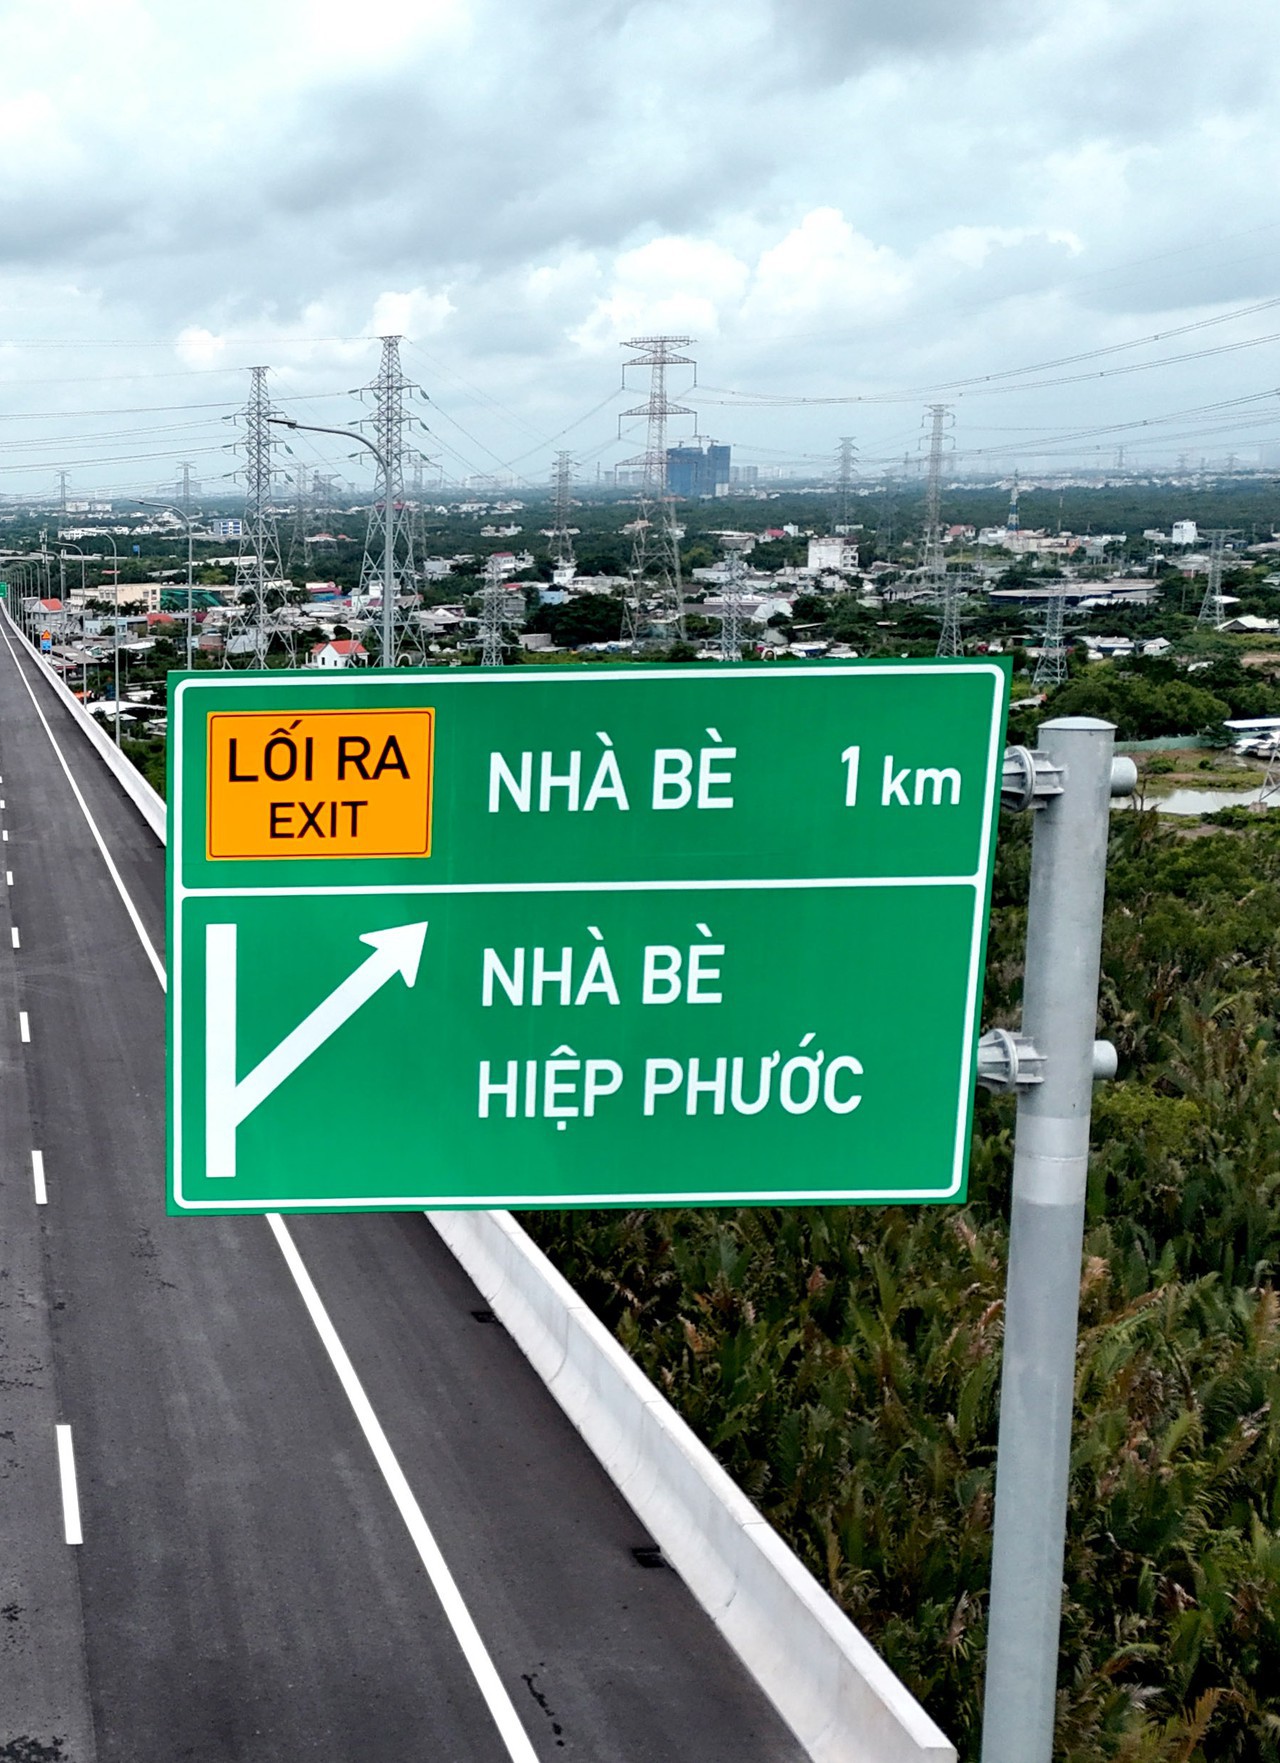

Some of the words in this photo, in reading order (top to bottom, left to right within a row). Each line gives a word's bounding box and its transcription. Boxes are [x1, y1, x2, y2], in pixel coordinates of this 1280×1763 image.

[229, 719, 313, 783] LỐI
[337, 735, 410, 781] RA
[488, 731, 630, 813] NHÀ
[652, 727, 737, 810] BÈ
[840, 745, 860, 808] 1
[881, 755, 962, 806] km
[269, 801, 368, 839] EXIT
[482, 926, 620, 1007] NHÀ
[642, 923, 725, 1005] BÈ
[478, 1045, 624, 1131] HIỆP
[643, 1032, 864, 1117] PHƯỚC
